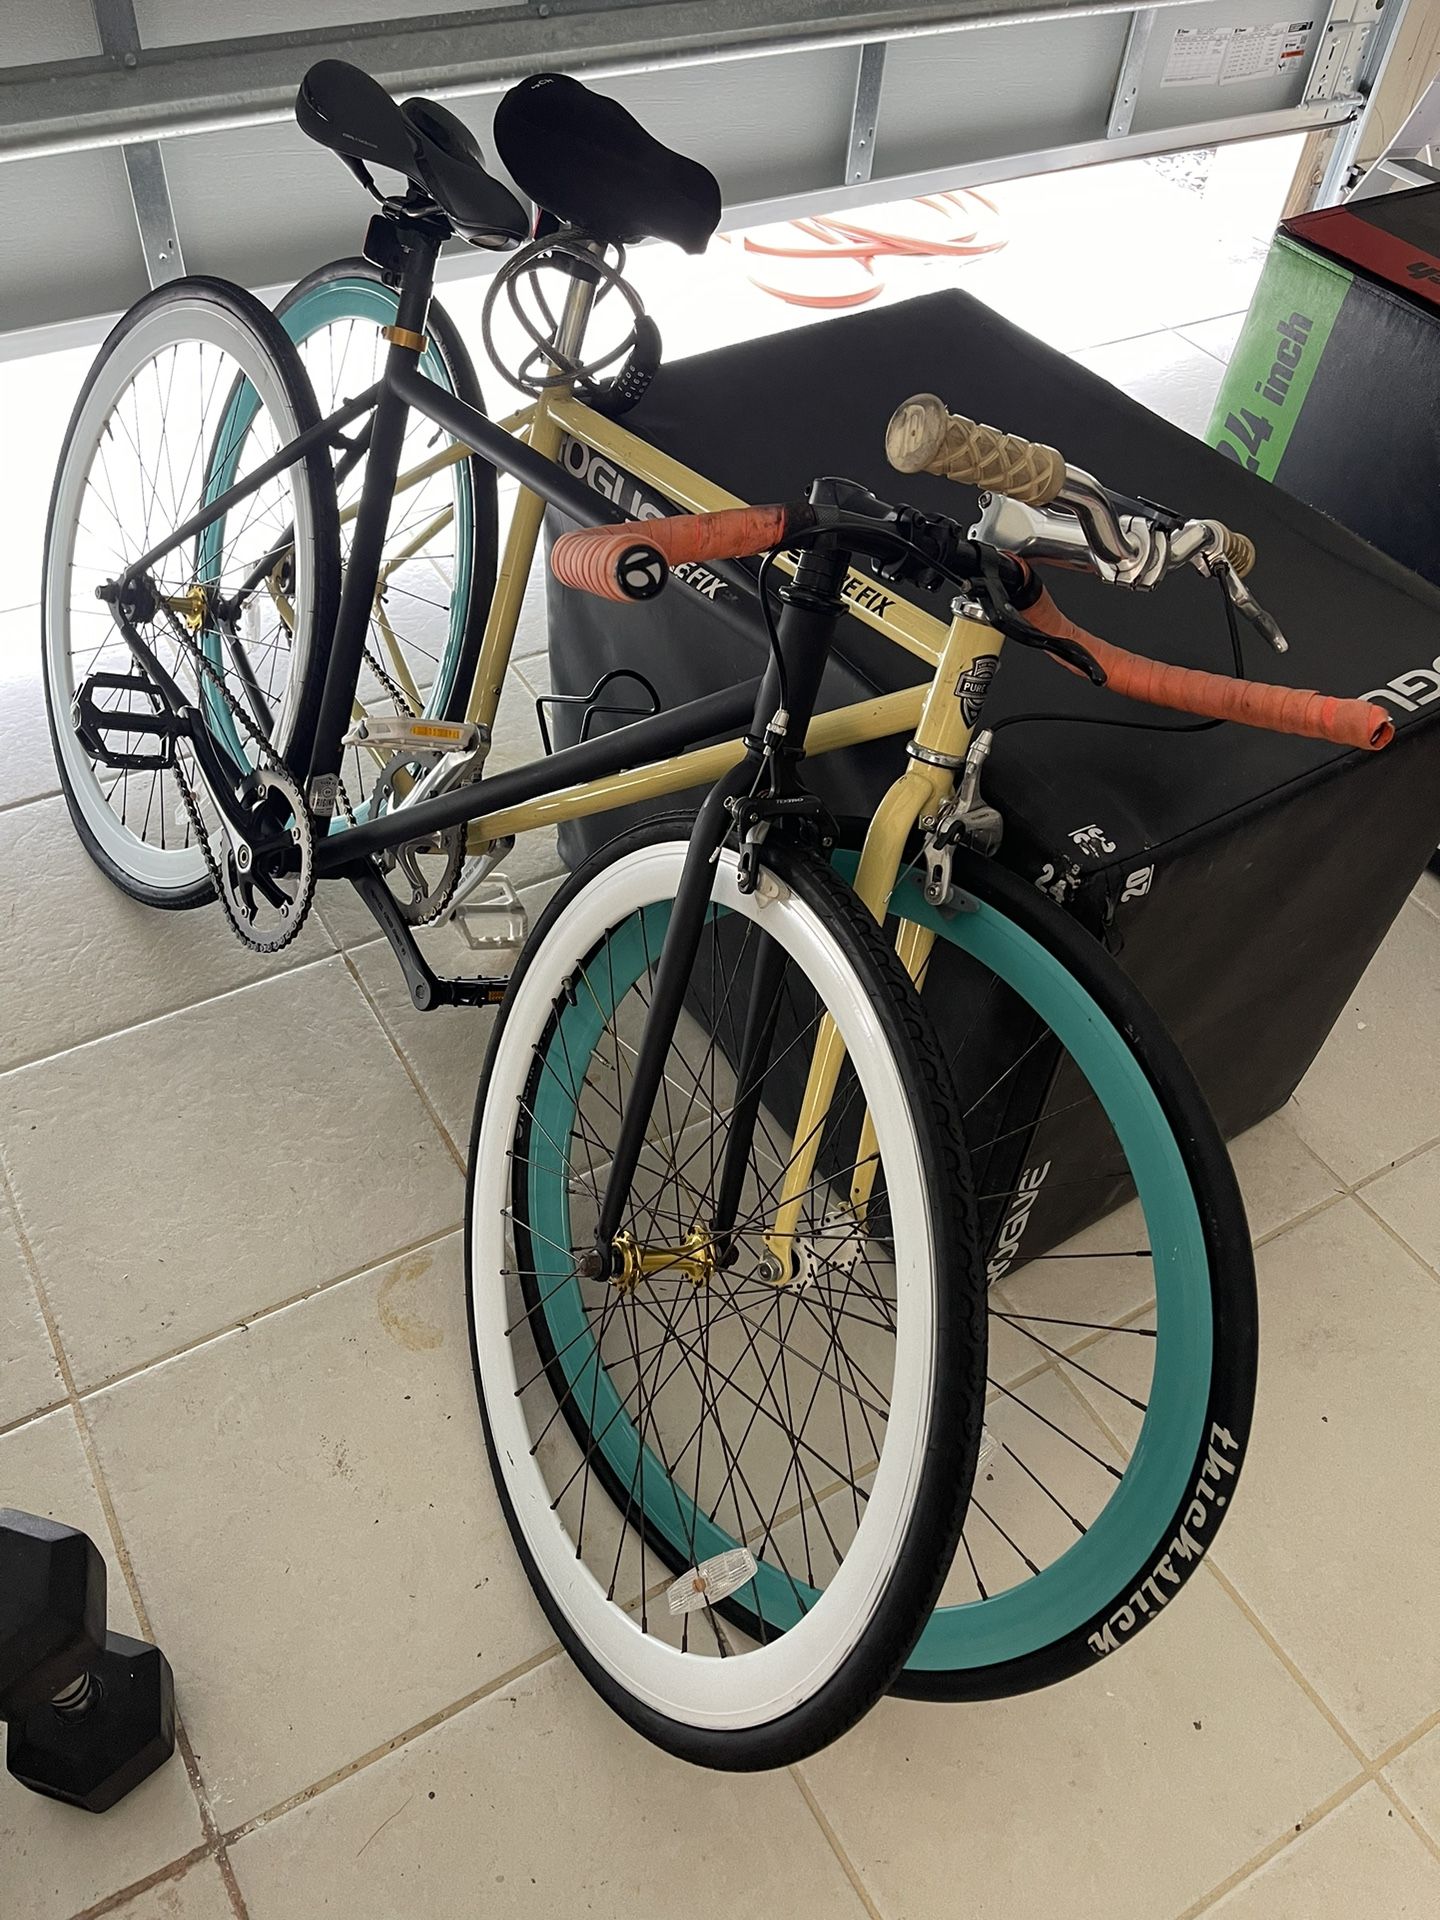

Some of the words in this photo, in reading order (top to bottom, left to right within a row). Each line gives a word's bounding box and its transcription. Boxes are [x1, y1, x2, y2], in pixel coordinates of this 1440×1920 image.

[1255, 311, 1314, 406] inch
[558, 433, 667, 522] OGU
[669, 561, 729, 600] EFIX
[841, 574, 896, 618] EFIX
[1121, 865, 1154, 903] 20
